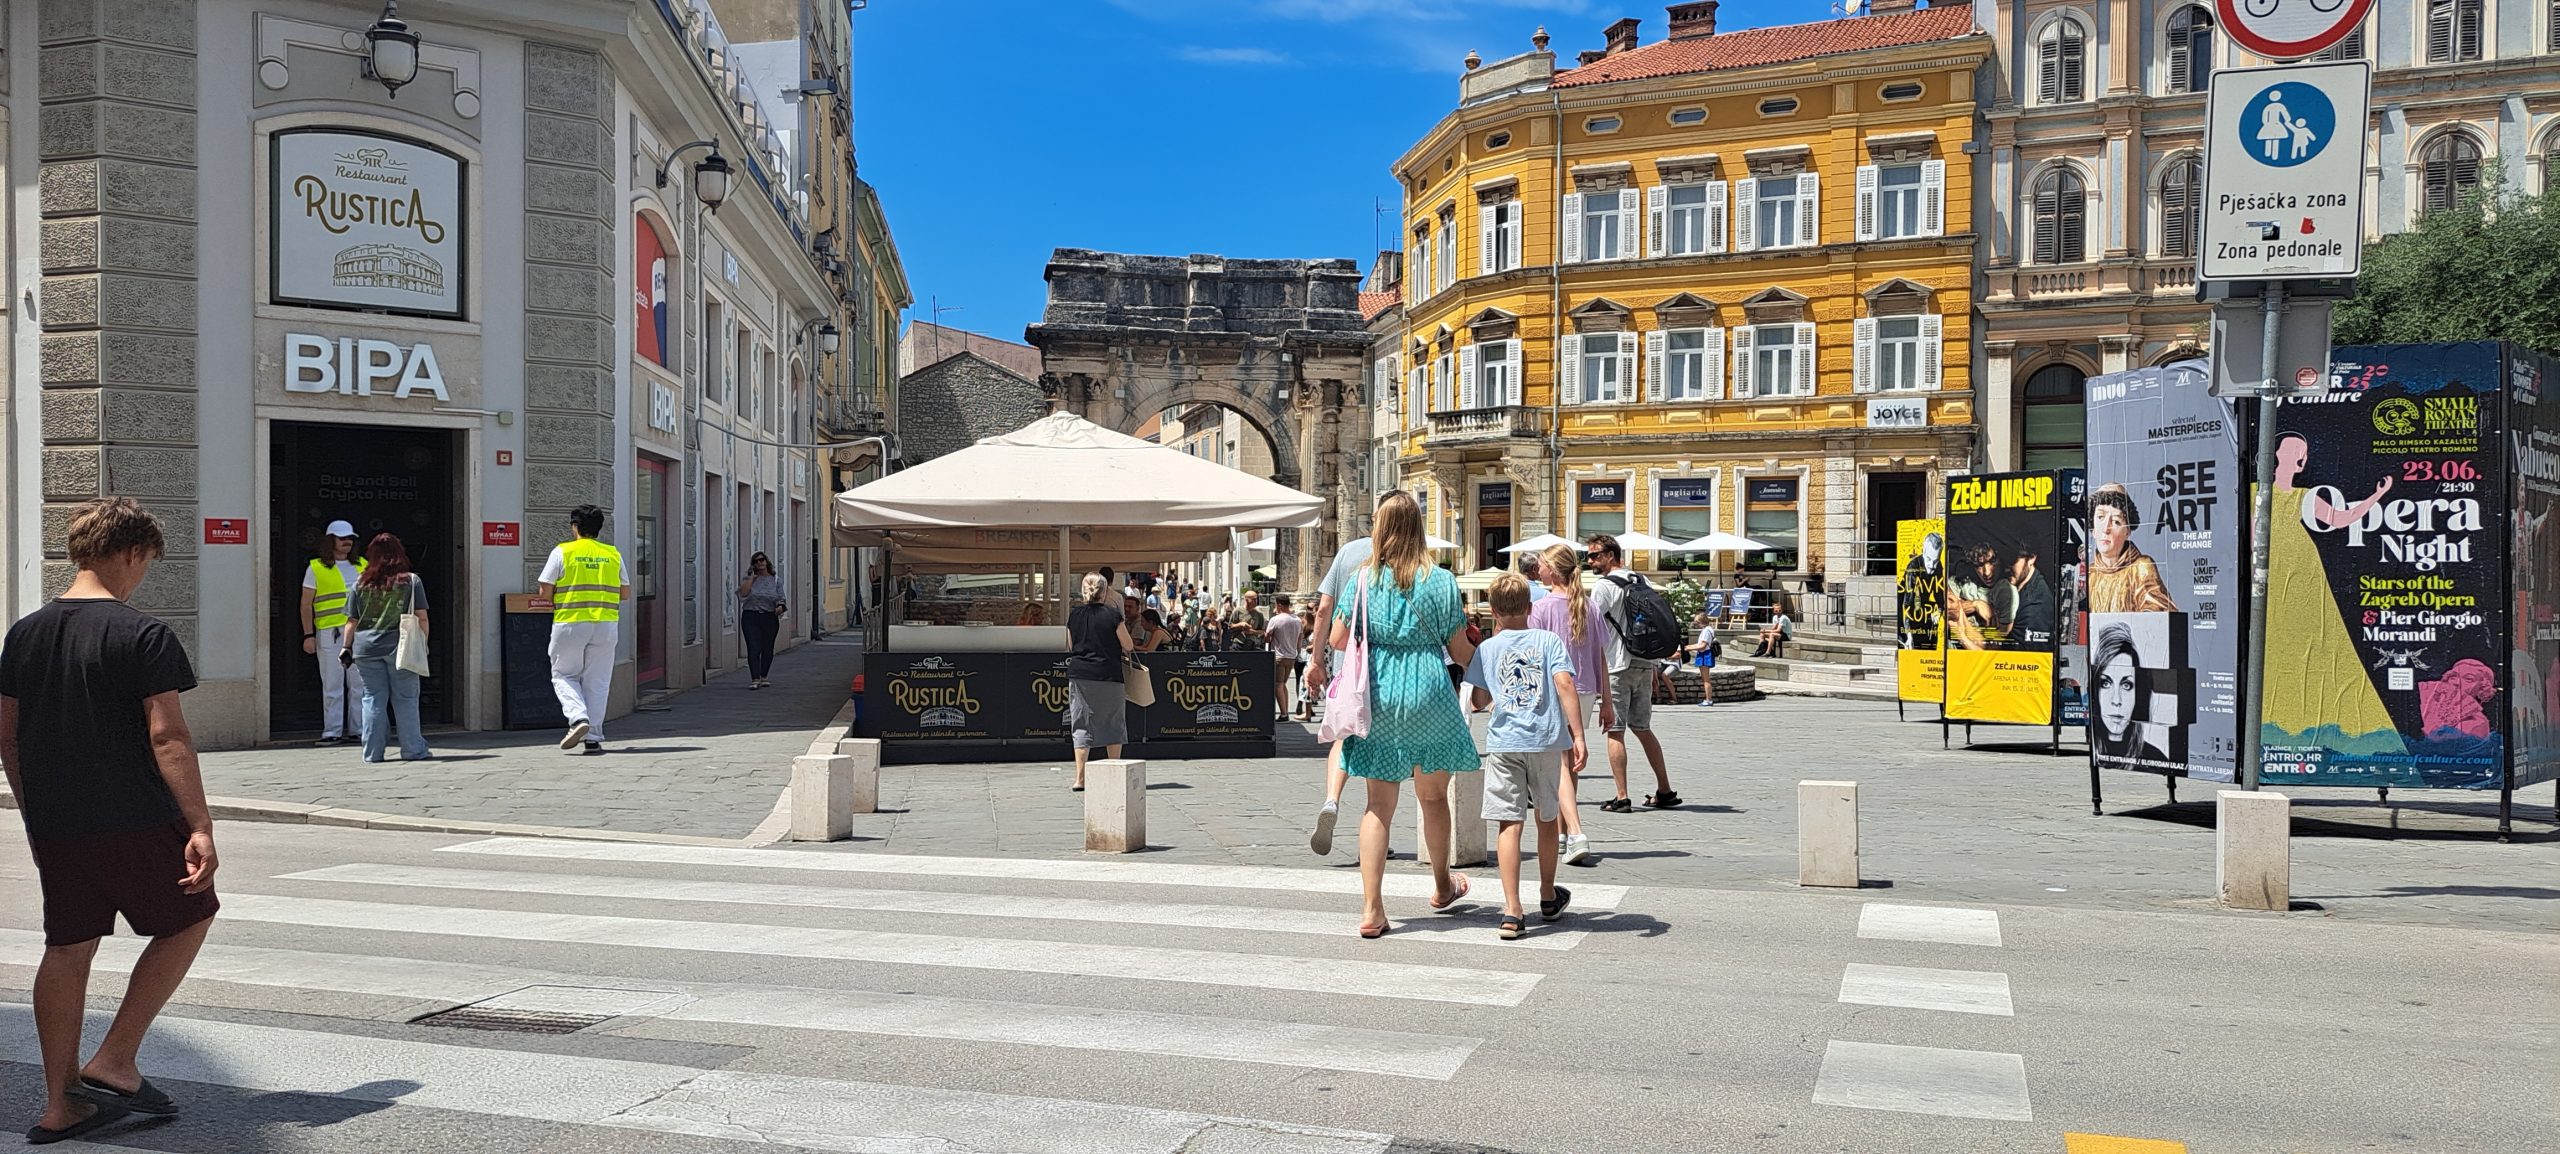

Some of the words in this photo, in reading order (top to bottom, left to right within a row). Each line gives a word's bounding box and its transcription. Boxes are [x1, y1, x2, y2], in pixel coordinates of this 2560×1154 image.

[335, 165, 408, 186] Restaurant
[2219, 192, 2297, 215] Pješačka
[2306, 193, 2347, 208] zona
[2217, 243, 2257, 259] Zona
[2266, 239, 2342, 261] pedonale
[285, 333, 450, 401] BIPA
[650, 380, 679, 436] BIPA
[2424, 397, 2477, 410] SMALL
[1874, 405, 1921, 421] JOYCE
[2425, 409, 2477, 420] ROMAN
[2148, 420, 2222, 439] MASTERPIECES
[2424, 420, 2477, 429] THEATRE
[2433, 437, 2477, 445] KAZALIŠTE
[2511, 429, 2560, 482] Nabucco
[2402, 460, 2483, 480] 23.06.
[320, 474, 352, 488] Buy
[355, 475, 384, 486] and
[389, 475, 416, 487] Sell
[2155, 460, 2216, 500] SEE
[319, 488, 374, 502] Crypto
[1590, 487, 1615, 498] jana
[1664, 488, 1707, 498] gagliardo
[1951, 477, 1997, 511] ZEČJI
[2001, 476, 2053, 508] NASIP
[2155, 497, 2217, 535] ART
[2302, 485, 2483, 547] Opera
[976, 529, 1060, 544] BREAKFAS
[2183, 532, 2196, 540] THE
[2198, 532, 2212, 540] ART
[2182, 540, 2212, 549] CHANGE
[2379, 534, 2473, 571] Night
[2193, 558, 2208, 567] VIDI
[2193, 566, 2220, 576] UMJET-
[1897, 575, 1945, 594] SLAVK
[2193, 576, 2213, 585] NOST
[2360, 575, 2405, 590] Stars
[2407, 575, 2425, 590] of
[2425, 575, 2455, 590] the
[2199, 602, 2216, 611] VEDI
[2360, 592, 2421, 609] Zagreb
[2422, 593, 2475, 610] Opera
[1902, 604, 1940, 623] KOPA
[2193, 611, 2216, 620] L'ARTE
[2362, 611, 2378, 625] &
[2380, 610, 2416, 625] Pier
[2418, 611, 2482, 630] Giorgio
[2362, 626, 2437, 642] Morandi
[1187, 668, 1227, 677] Restaurant
[1995, 662, 2015, 670] ZEČJI
[2017, 663, 2039, 671] NASIP
[910, 670, 954, 678] Restaurant
[2264, 753, 2322, 762] ENTRIO.HR
[2189, 764, 2214, 772] ENTRATA
[2264, 762, 2317, 774] ENTRIO
